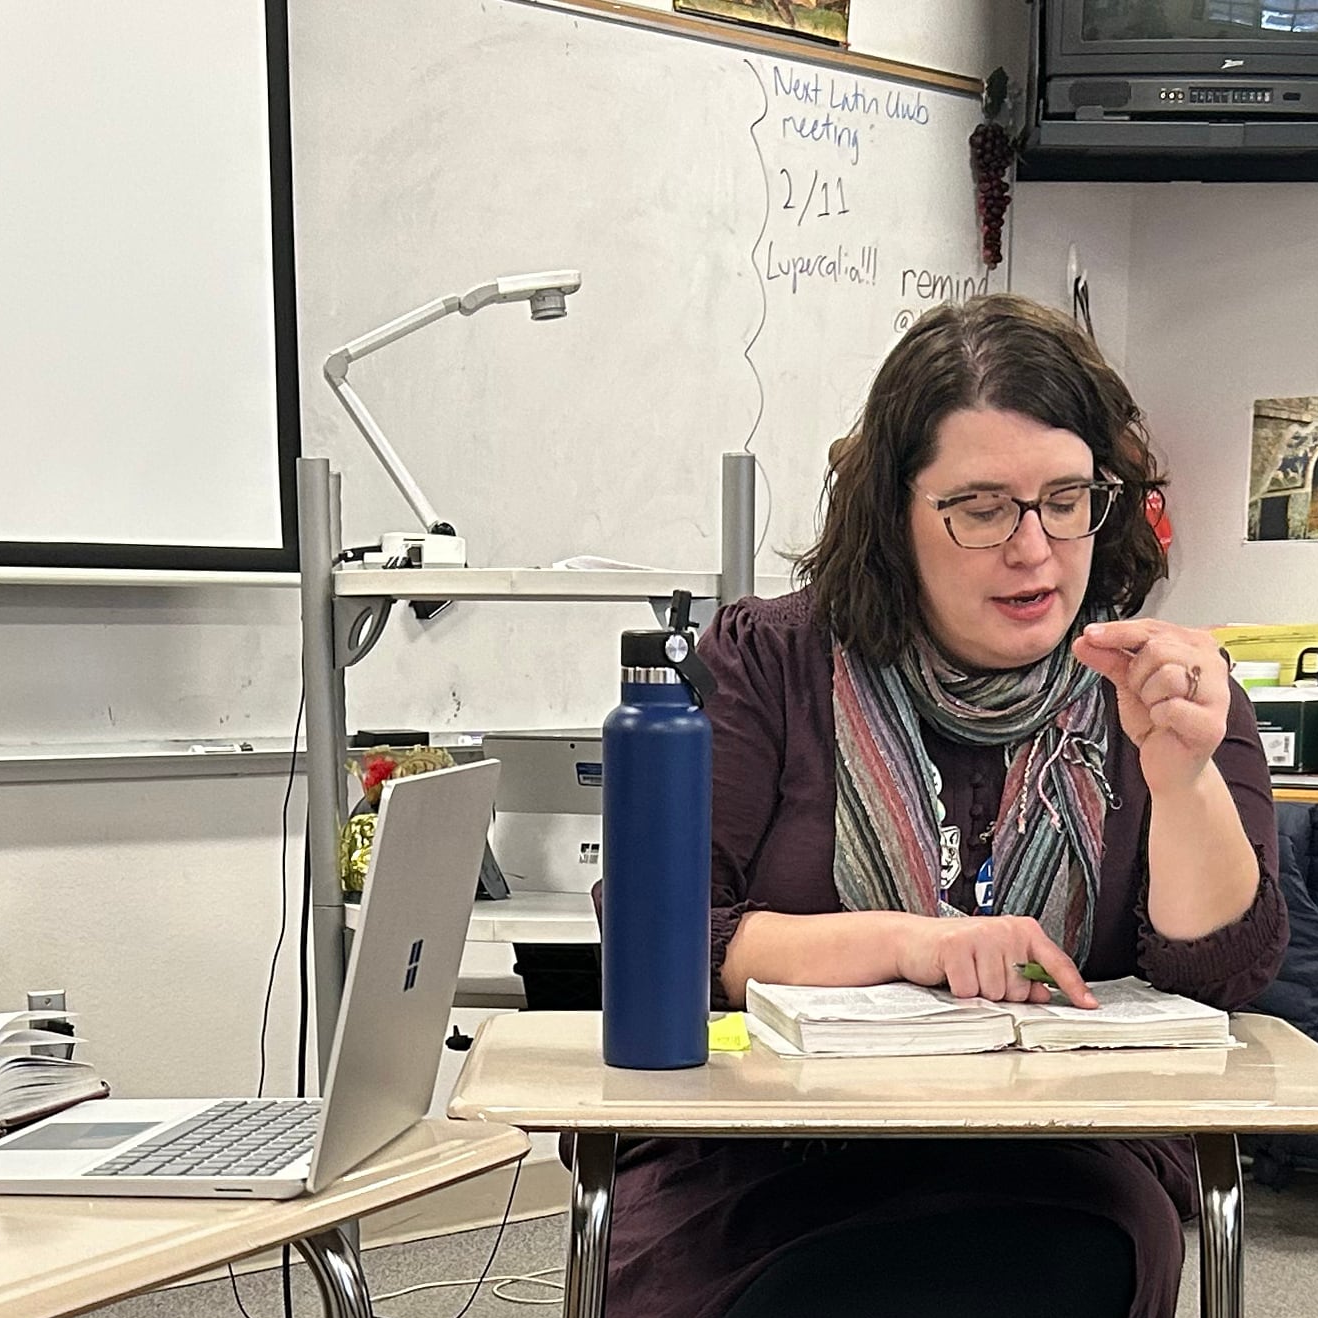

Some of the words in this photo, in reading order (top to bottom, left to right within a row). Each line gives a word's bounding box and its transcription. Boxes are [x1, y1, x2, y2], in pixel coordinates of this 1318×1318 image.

[773, 65, 822, 105] Next
[829, 79, 879, 115] Latin
[780, 168, 849, 227] 2/11
